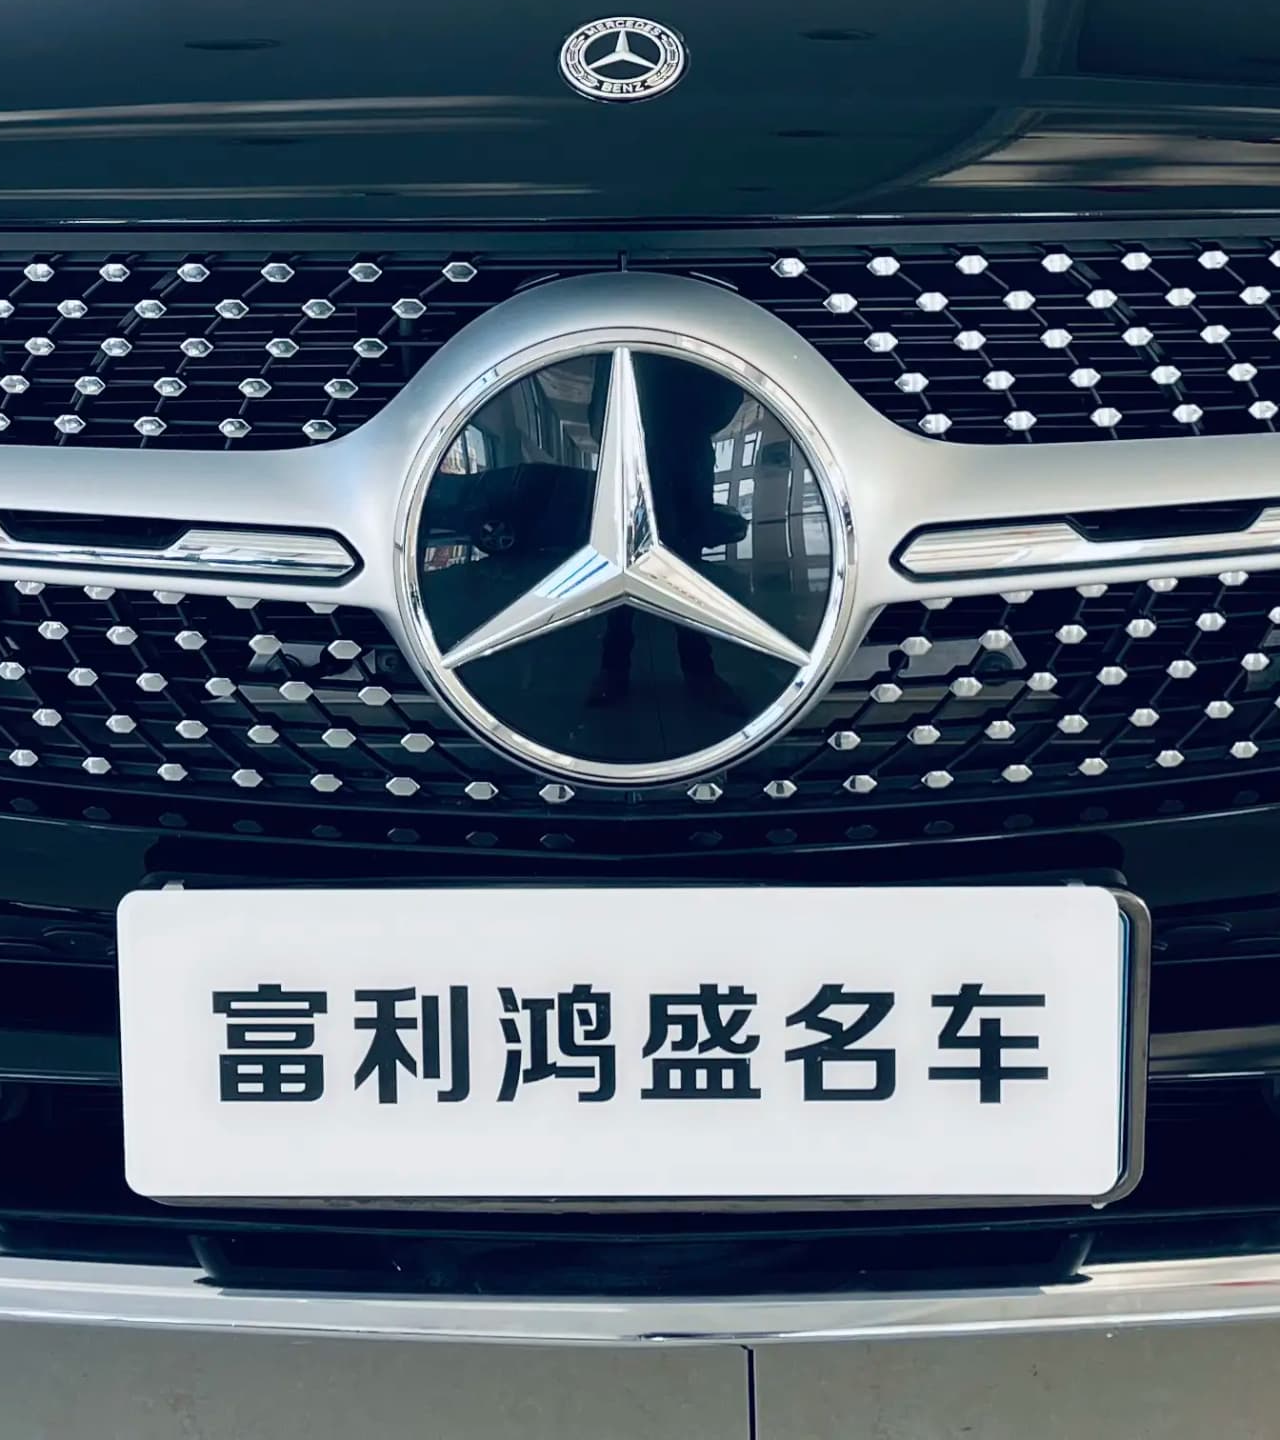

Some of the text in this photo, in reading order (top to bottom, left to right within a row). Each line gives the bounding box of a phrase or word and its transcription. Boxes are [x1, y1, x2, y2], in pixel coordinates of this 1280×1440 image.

[584, 20, 662, 35] MERCEDES
[601, 81, 644, 93] BENZ
[212, 983, 1049, 1104] 富利鸿盛名车
